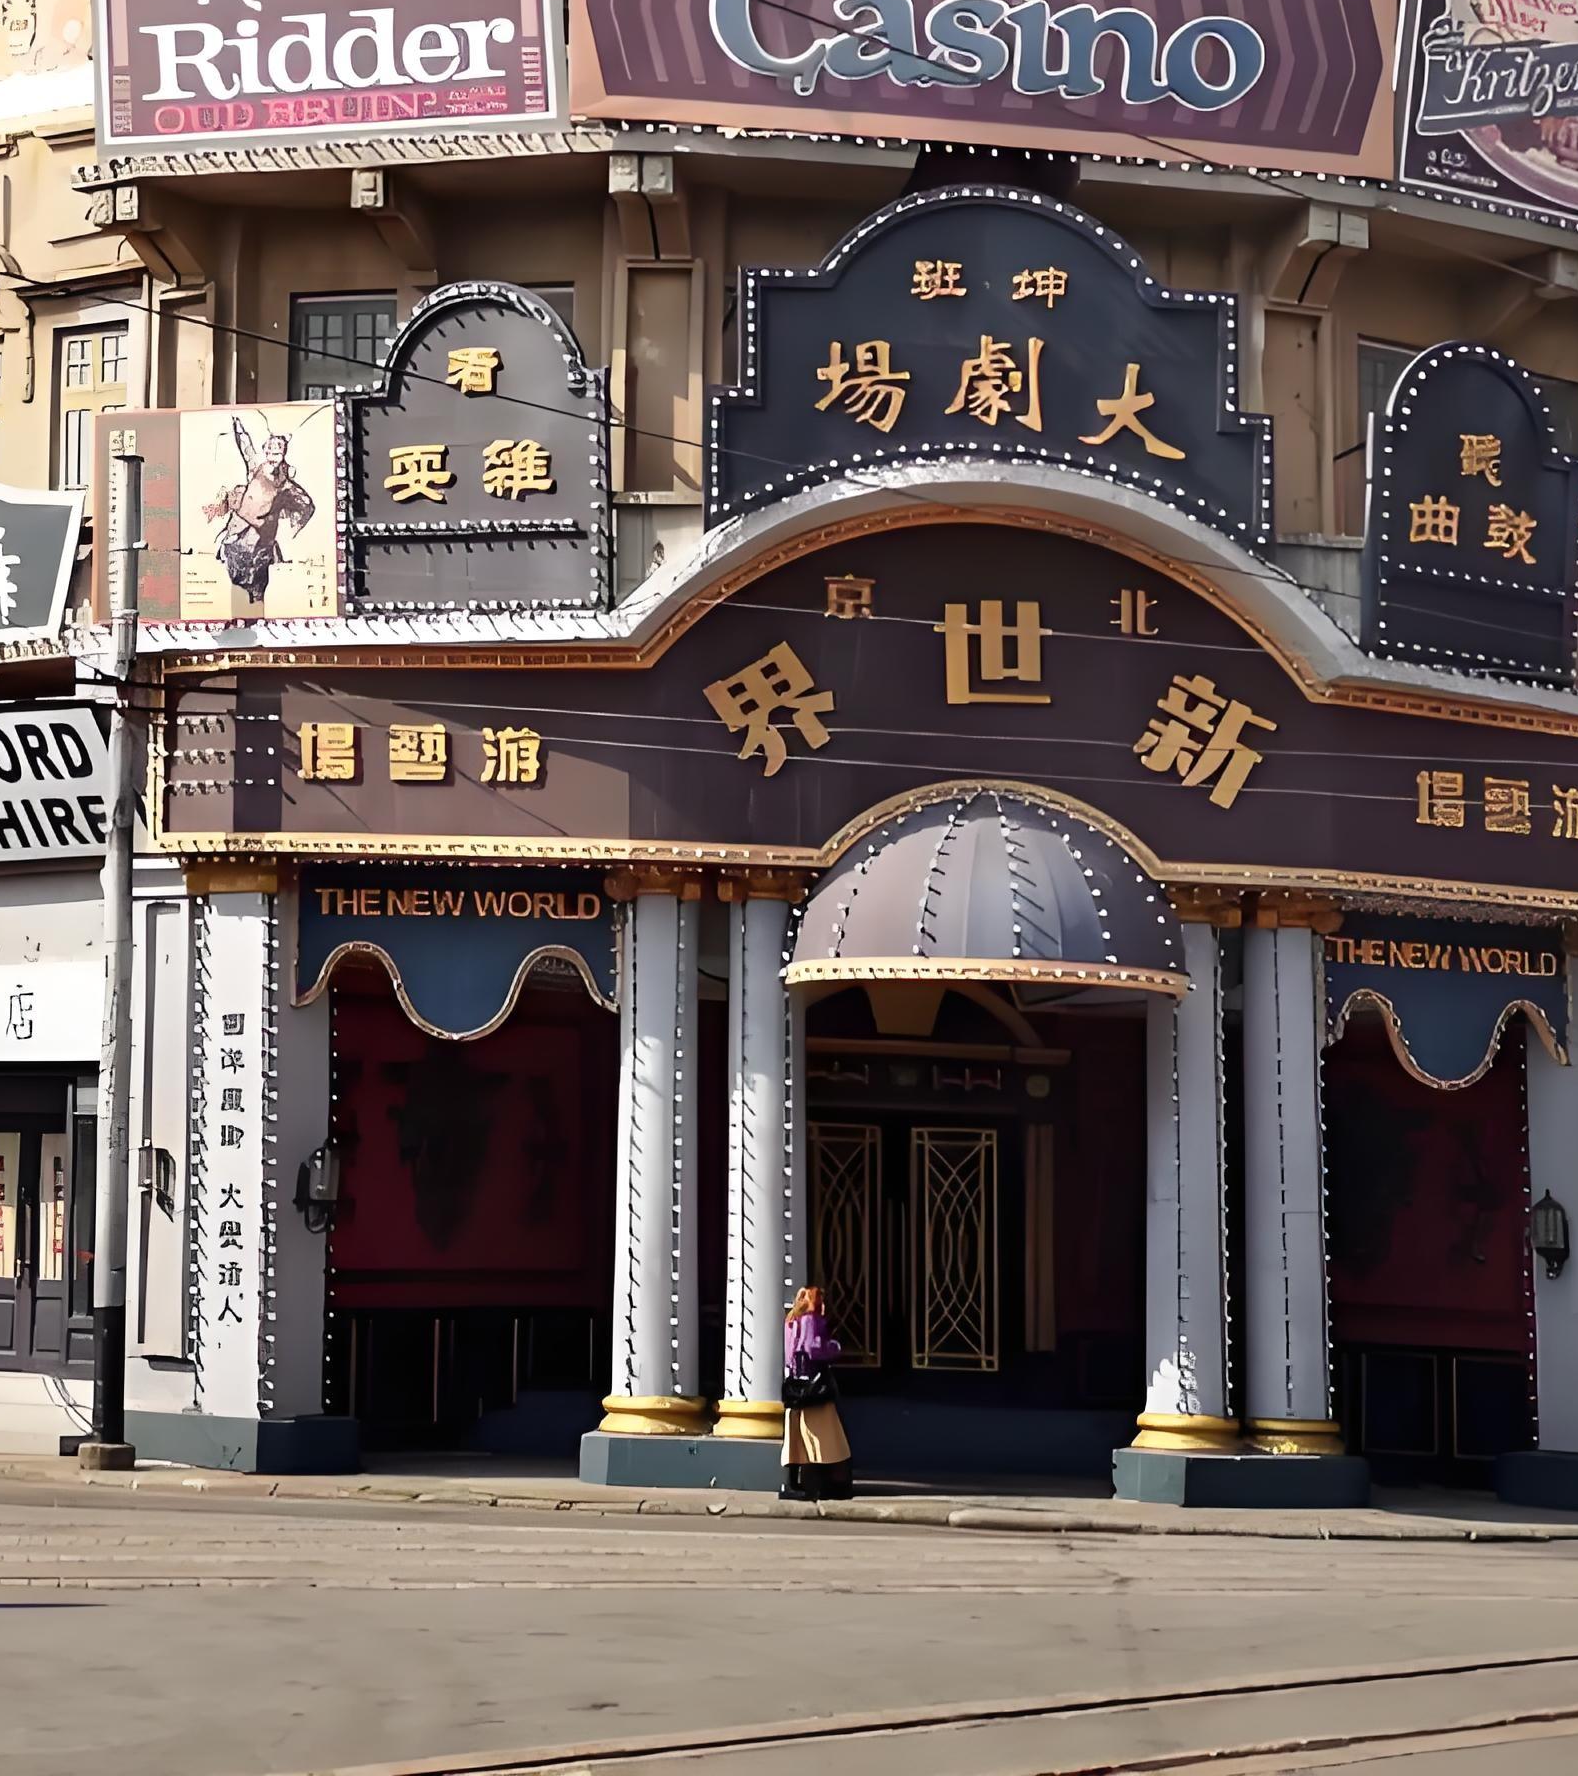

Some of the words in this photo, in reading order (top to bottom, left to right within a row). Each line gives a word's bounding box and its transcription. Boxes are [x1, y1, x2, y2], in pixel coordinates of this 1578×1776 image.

[139, 8, 515, 102] Ridder
[814, 334, 1186, 461] 大劇場
[315, 887, 381, 917] THE
[387, 889, 466, 918] NEW
[473, 889, 602, 921] WORLD
[1325, 935, 1387, 968] THE
[1389, 939, 1453, 972] NEW
[1458, 946, 1558, 977] WORLD
